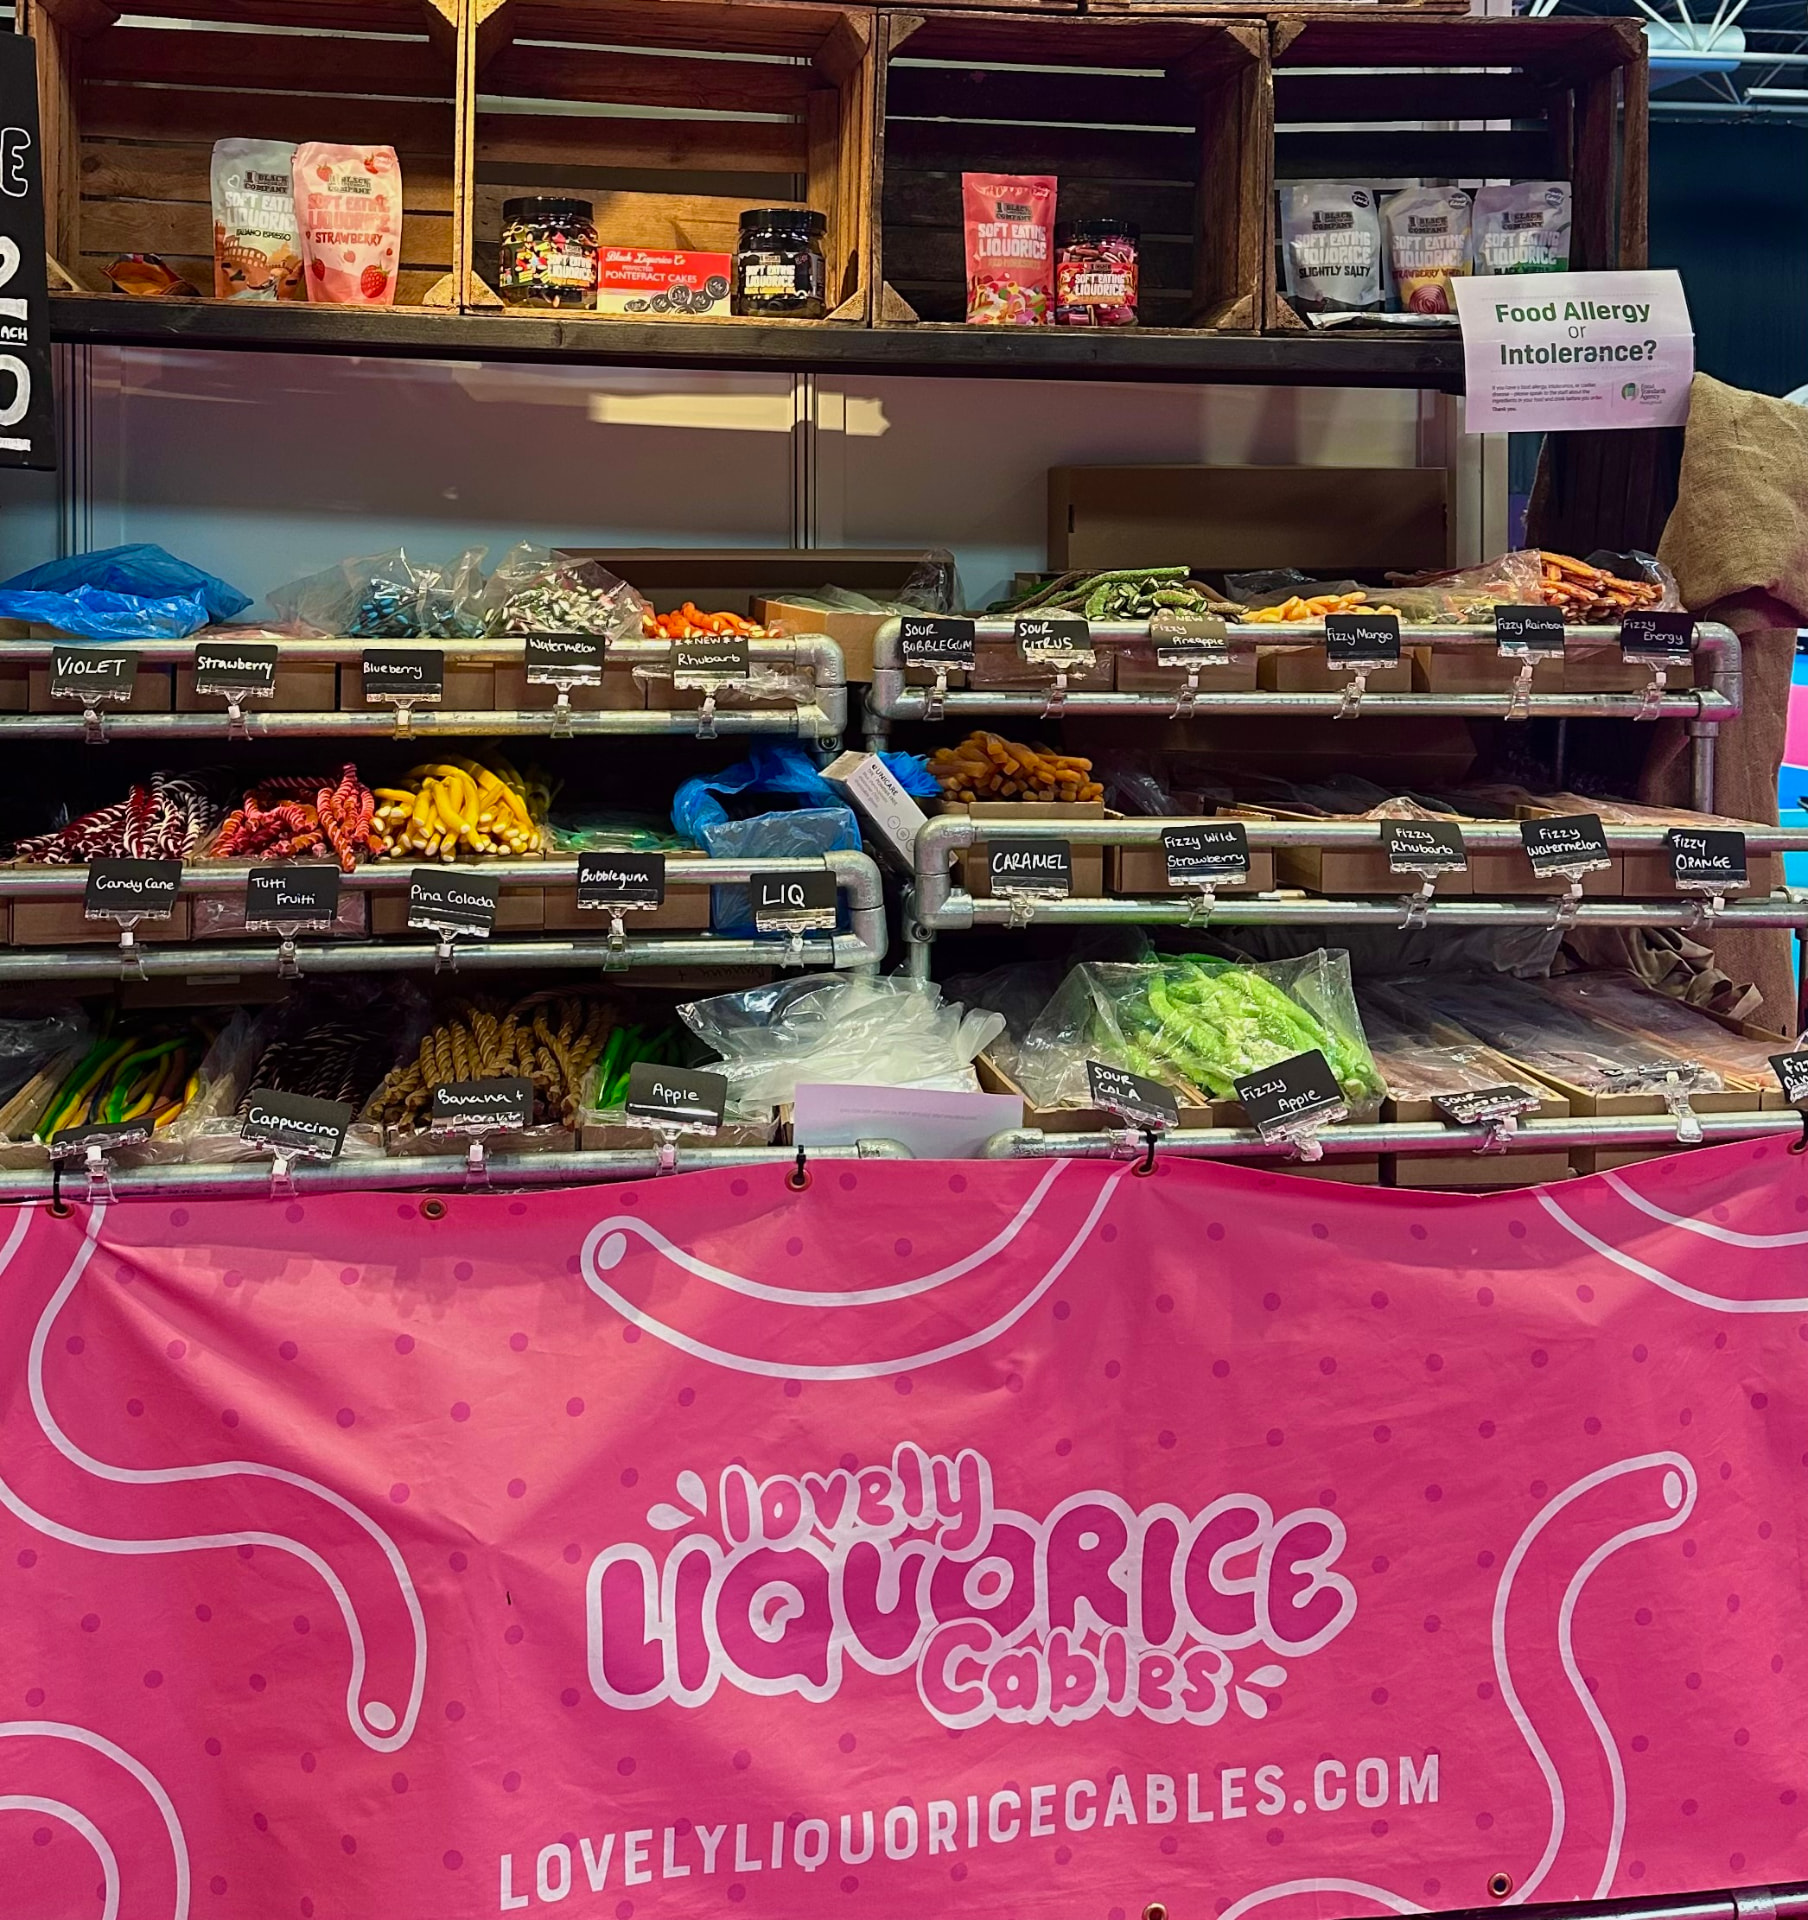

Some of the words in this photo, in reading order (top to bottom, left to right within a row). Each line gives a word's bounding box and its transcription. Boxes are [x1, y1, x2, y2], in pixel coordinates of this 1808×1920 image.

[224, 191, 259, 208] SOFT
[315, 231, 383, 246] STRAWBERRY
[978, 222, 1008, 238] SOFT
[1011, 224, 1046, 241] EATING
[1329, 232, 1371, 246] EATING
[1484, 233, 1517, 248] SOFT
[1519, 231, 1560, 246] EATING
[978, 238, 1047, 260] LIQUORICE
[1392, 236, 1422, 250] SOFT
[1425, 234, 1465, 250] EATING
[605, 270, 666, 283] PONTEFRACT
[667, 273, 698, 284] CAKES
[1075, 273, 1098, 284] SOFT
[1099, 273, 1125, 284] EATING
[1299, 265, 1342, 279] SLIGHTLY
[1344, 266, 1371, 278] SALTY
[1075, 283, 1125, 296] LIQUORICE
[1495, 302, 1557, 323] Food
[1564, 301, 1650, 323] Allergy
[1568, 325, 1586, 339] or
[1501, 340, 1657, 365] Intolerance?
[904, 623, 938, 637] SOUR
[1019, 622, 1054, 637] SOUR
[1152, 624, 1187, 635] Fizzy
[1498, 617, 1523, 635] Fizzy
[1623, 618, 1655, 632] Fizzy
[694, 636, 722, 645] NEW
[1022, 637, 1074, 650] CITRUS
[1172, 636, 1225, 648] Pineapple
[1326, 627, 1356, 646] Fizzy
[1356, 627, 1393, 645] Mango
[1643, 631, 1685, 646] Energy
[529, 638, 597, 653] Watermelon
[57, 656, 127, 677] VIOLET
[677, 652, 741, 666] Rhubarb
[197, 656, 274, 680] Strawberry
[363, 661, 424, 680] Blueberry
[1164, 834, 1202, 850] Fizzy
[1203, 831, 1238, 843] Wild
[1395, 827, 1436, 844] Fizzy
[1538, 828, 1581, 841] Fizzy
[1391, 840, 1454, 855] Rhubarb
[992, 852, 1068, 873] CARAMEL
[1167, 854, 1246, 869] Strawberry
[1675, 854, 1732, 870] ORANGE
[96, 875, 143, 893] Candy
[144, 877, 175, 891] Cane
[252, 877, 286, 890] Tutti
[580, 868, 649, 890] Bubblegum
[276, 893, 316, 906] Fruitti
[410, 884, 443, 902] Pina
[447, 890, 496, 909] Colada
[762, 884, 806, 908] LIQ
[1094, 1066, 1135, 1086] SOUR
[438, 1088, 513, 1105] Banana
[652, 1082, 700, 1106] Apple
[1098, 1082, 1142, 1102] COLA
[1239, 1077, 1287, 1102] Fizzy
[1278, 1087, 1322, 1112] Apple
[249, 1106, 340, 1137] Cappuccino
[917, 1617, 1234, 1730] Cables
[499, 1754, 1440, 1911] LOVELYLIQUORICECABLES.COM
